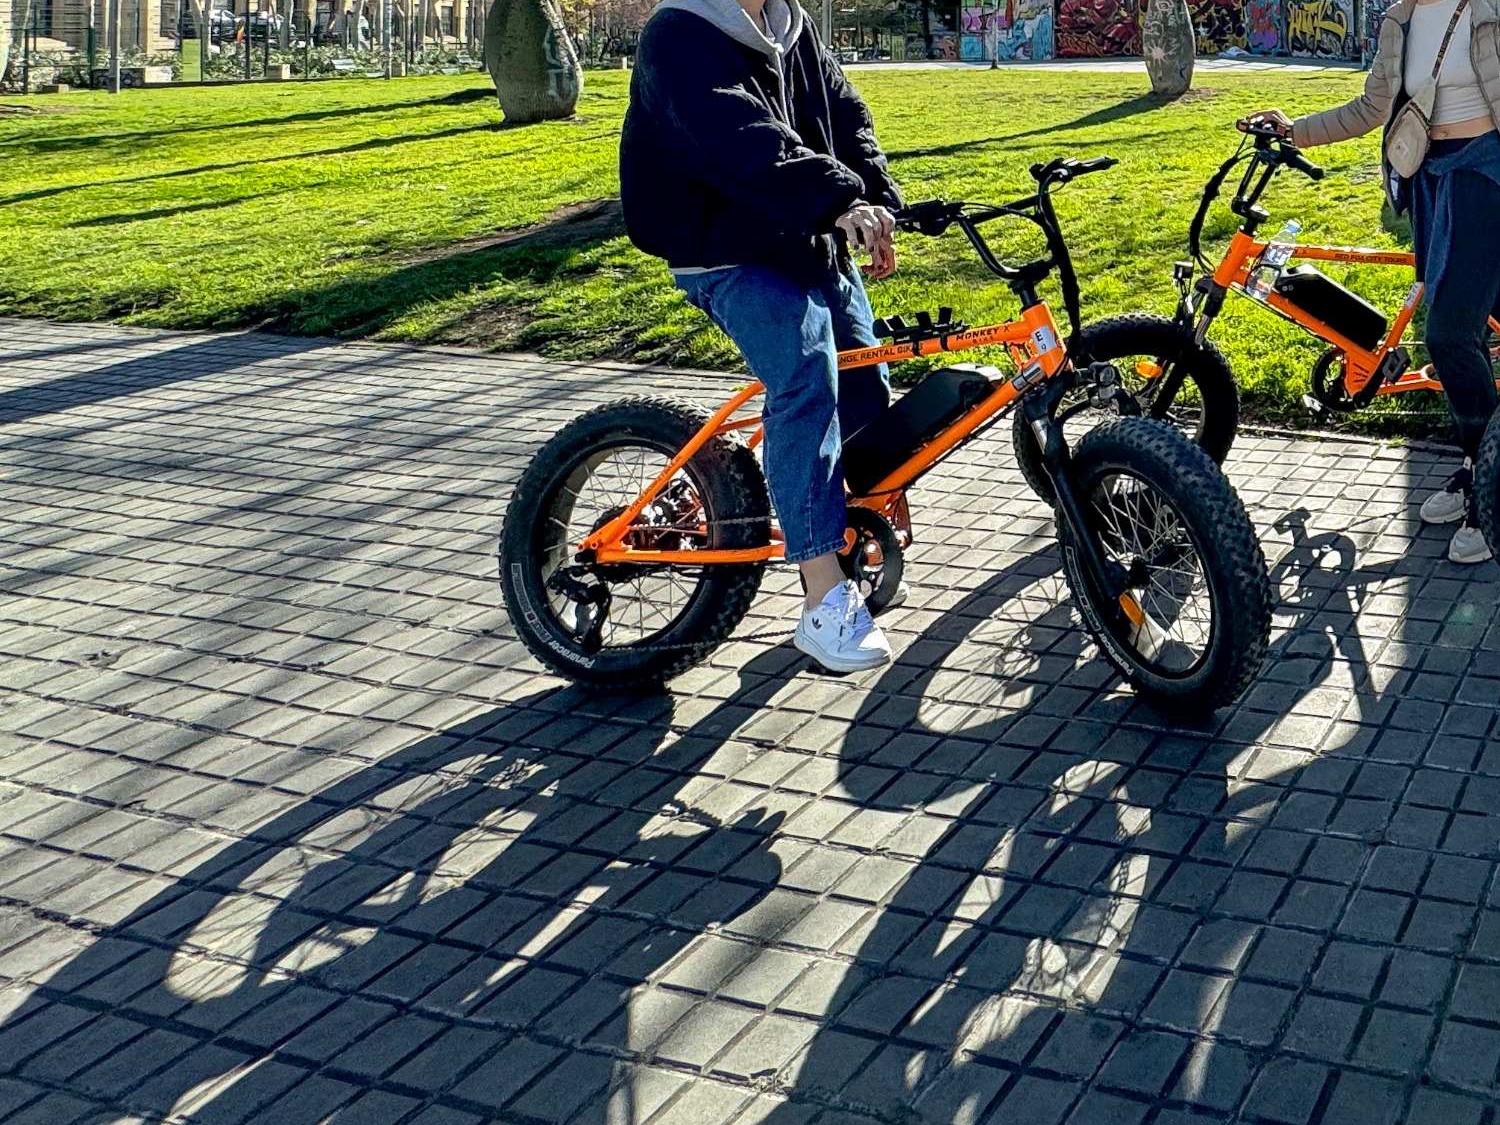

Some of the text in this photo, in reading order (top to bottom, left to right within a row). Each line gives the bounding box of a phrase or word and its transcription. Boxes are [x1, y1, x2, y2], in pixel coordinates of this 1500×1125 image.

[956, 325, 1010, 342] MONKEY X
[1034, 330, 1043, 342] E
[1040, 343, 1047, 351] 9
[838, 353, 860, 364] NGE
[860, 348, 895, 361] RENTAL
[549, 640, 596, 669] Panaracer
